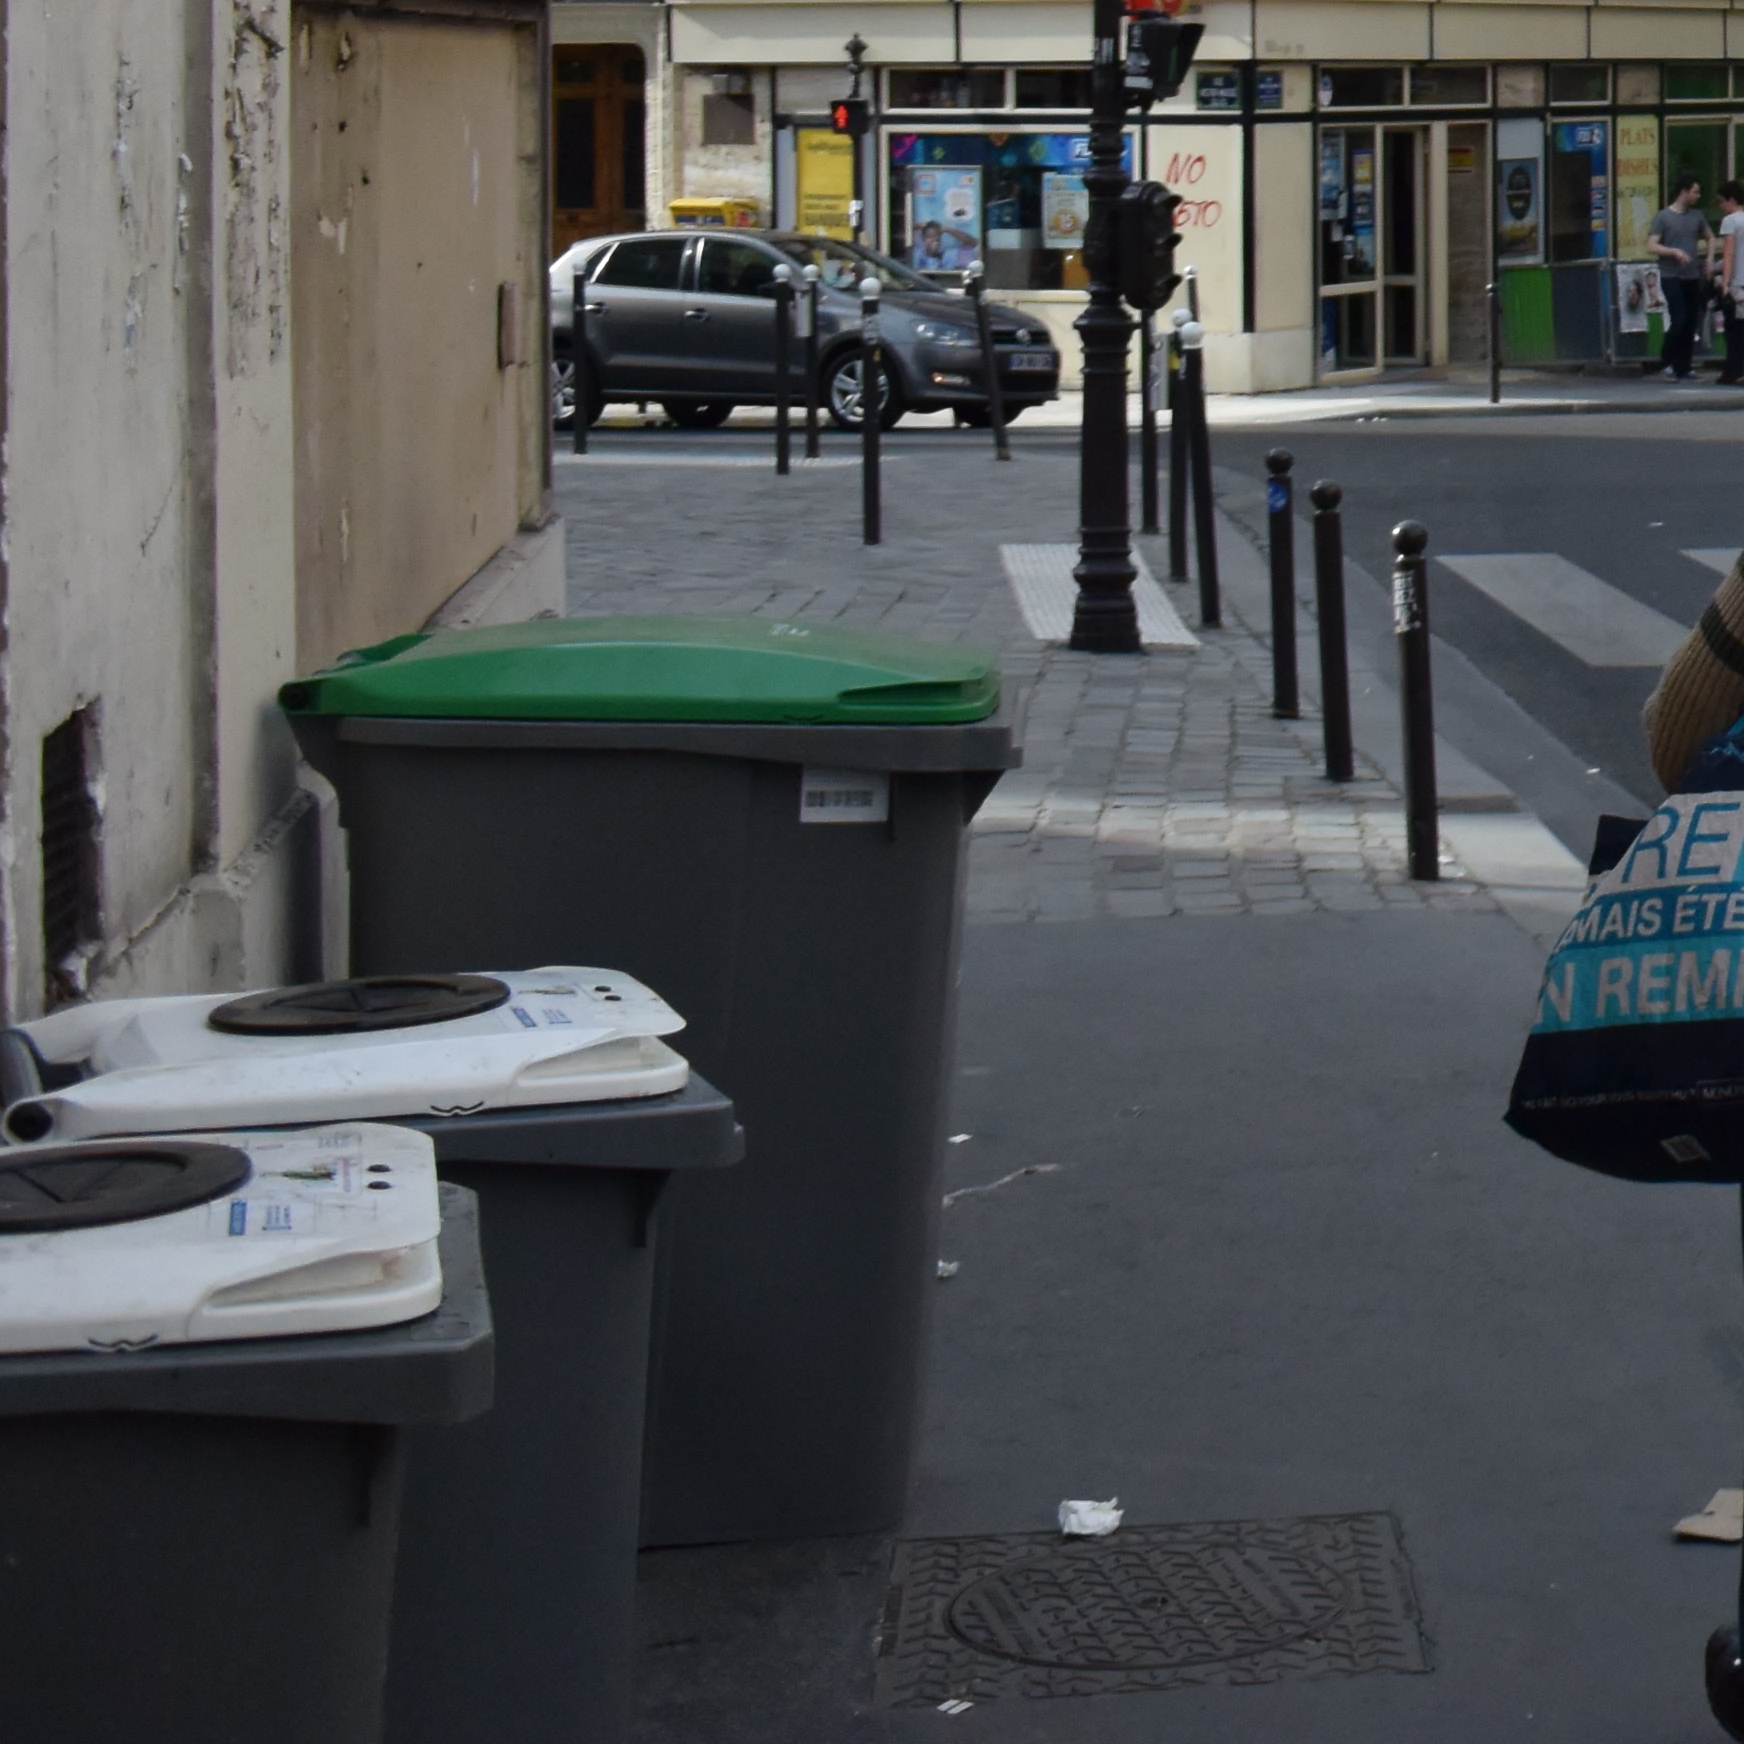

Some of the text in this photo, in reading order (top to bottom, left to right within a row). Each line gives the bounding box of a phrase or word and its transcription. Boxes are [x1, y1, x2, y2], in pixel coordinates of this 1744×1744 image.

[1619, 125, 1655, 145] PLATS
[1165, 151, 1207, 185] NO
[1622, 799, 1741, 886] RE
